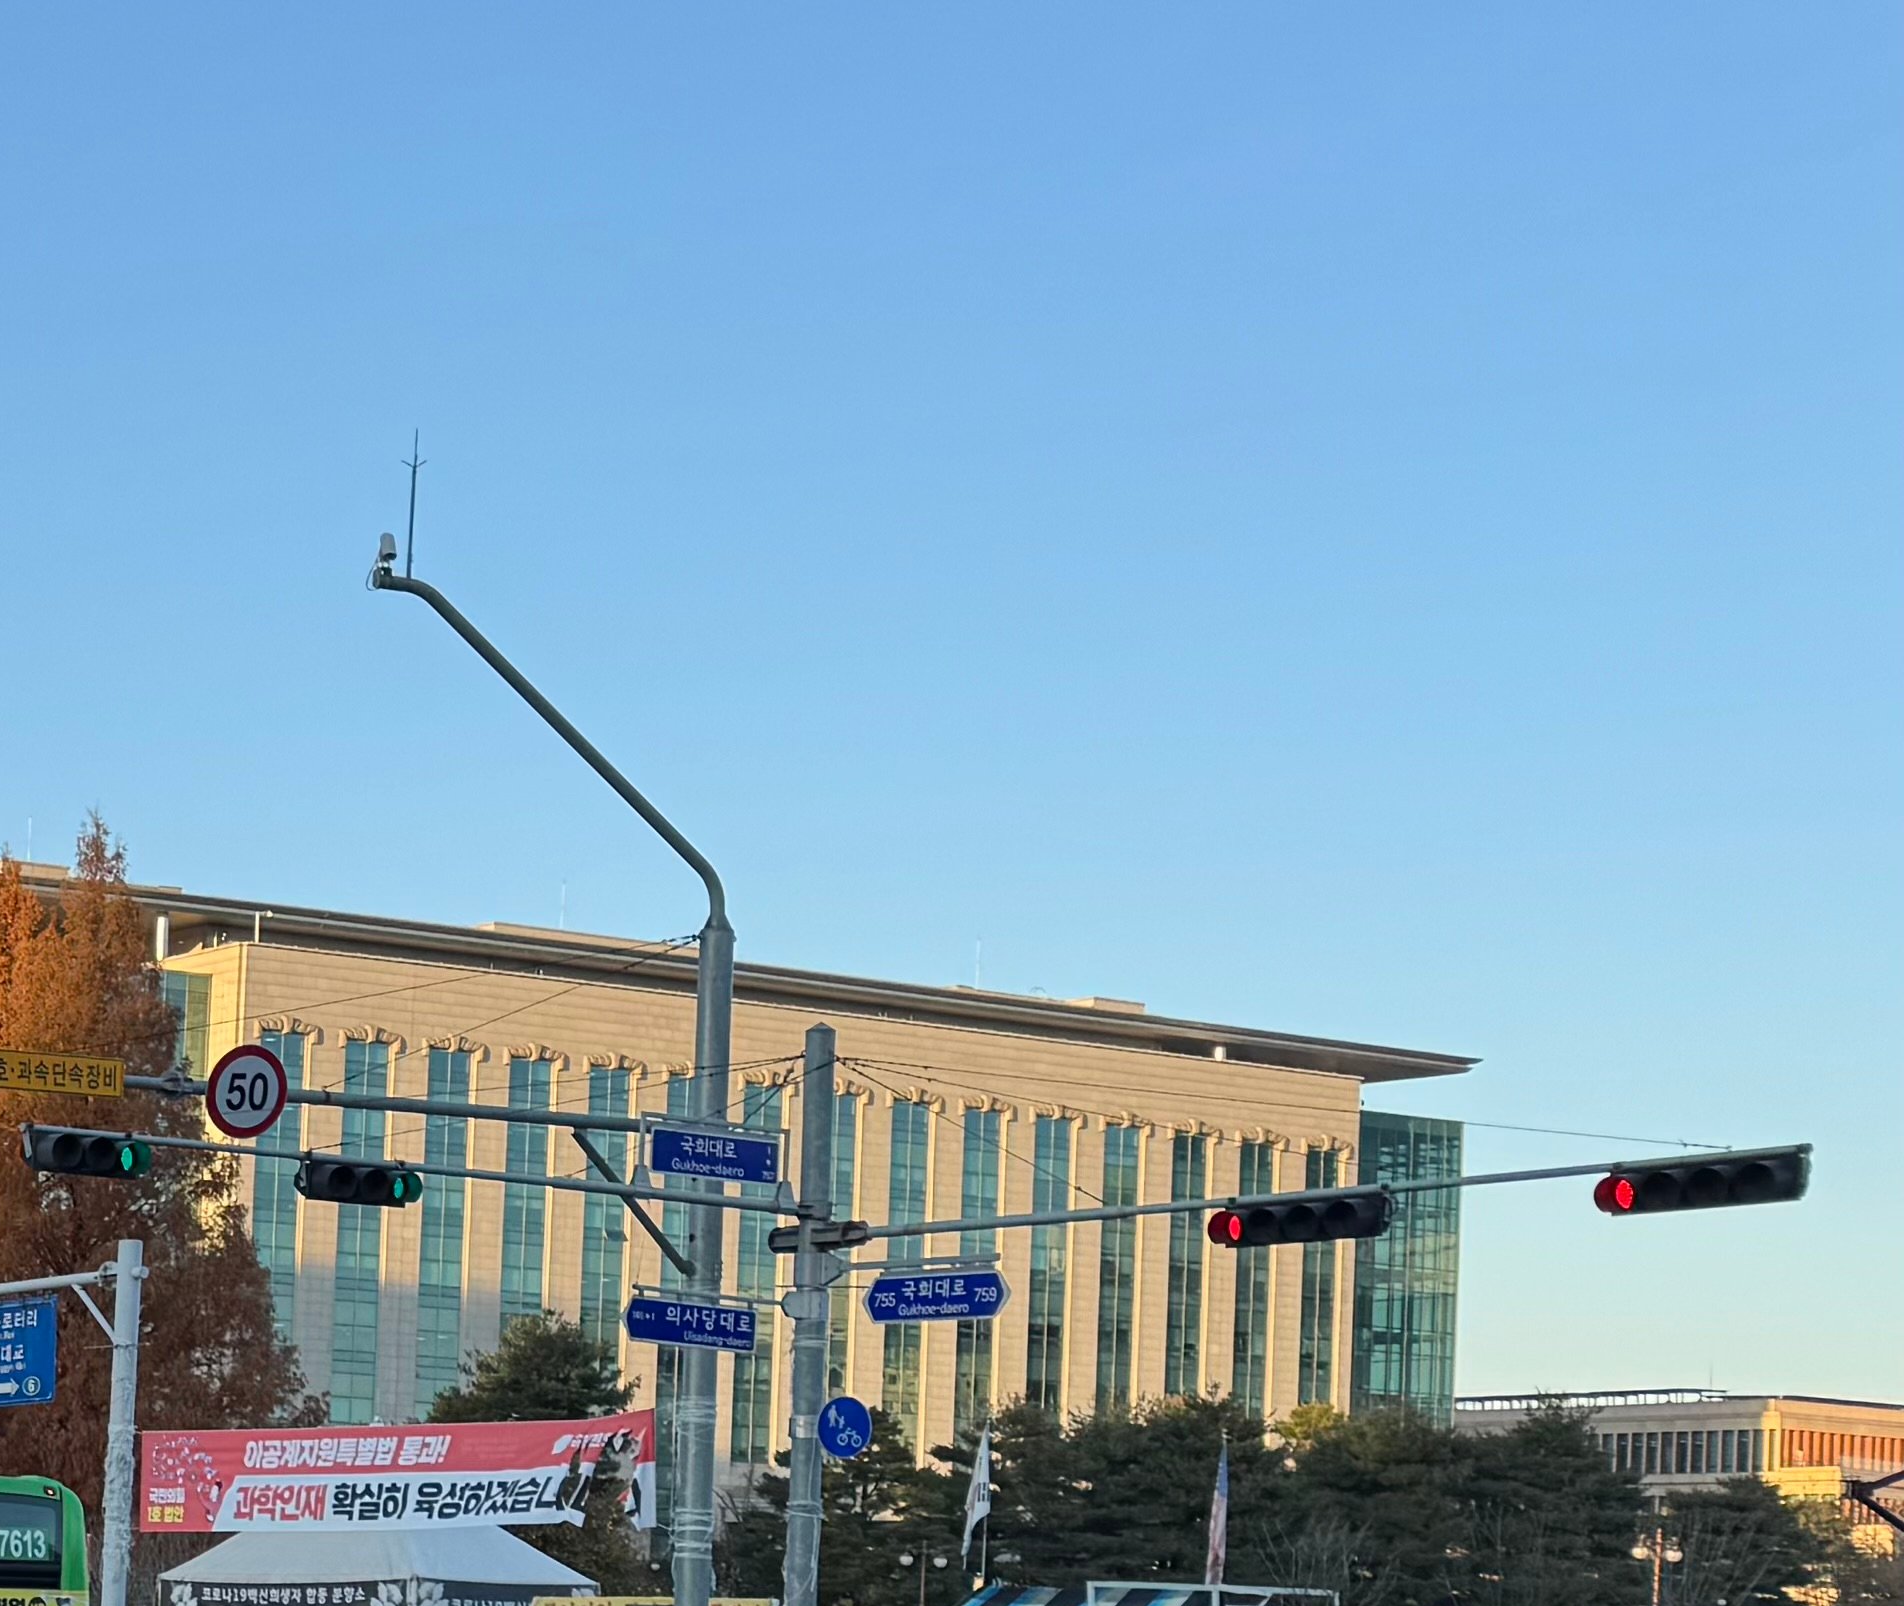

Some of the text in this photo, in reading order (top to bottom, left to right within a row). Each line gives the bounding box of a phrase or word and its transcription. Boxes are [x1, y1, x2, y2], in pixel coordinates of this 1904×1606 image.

[225, 1071, 270, 1112] 50
[680, 1135, 738, 1159] 국회대로
[671, 1157, 745, 1178] Gukhoe-daero
[874, 1292, 897, 1308] 755
[901, 1277, 968, 1301] 국회대로
[973, 1286, 998, 1303] 759
[665, 1305, 753, 1333] 의사당대로
[898, 1302, 970, 1317] Gukhoe-daero
[683, 1329, 752, 1349] Uisadang-daero
[244, 1434, 452, 1469] 이공계지원특별법 통과!
[233, 1475, 640, 1521] 과학인재 확실히 육성하겠습니
[200, 1586, 367, 1605] 코로나19백신희생자 합동 분향소
